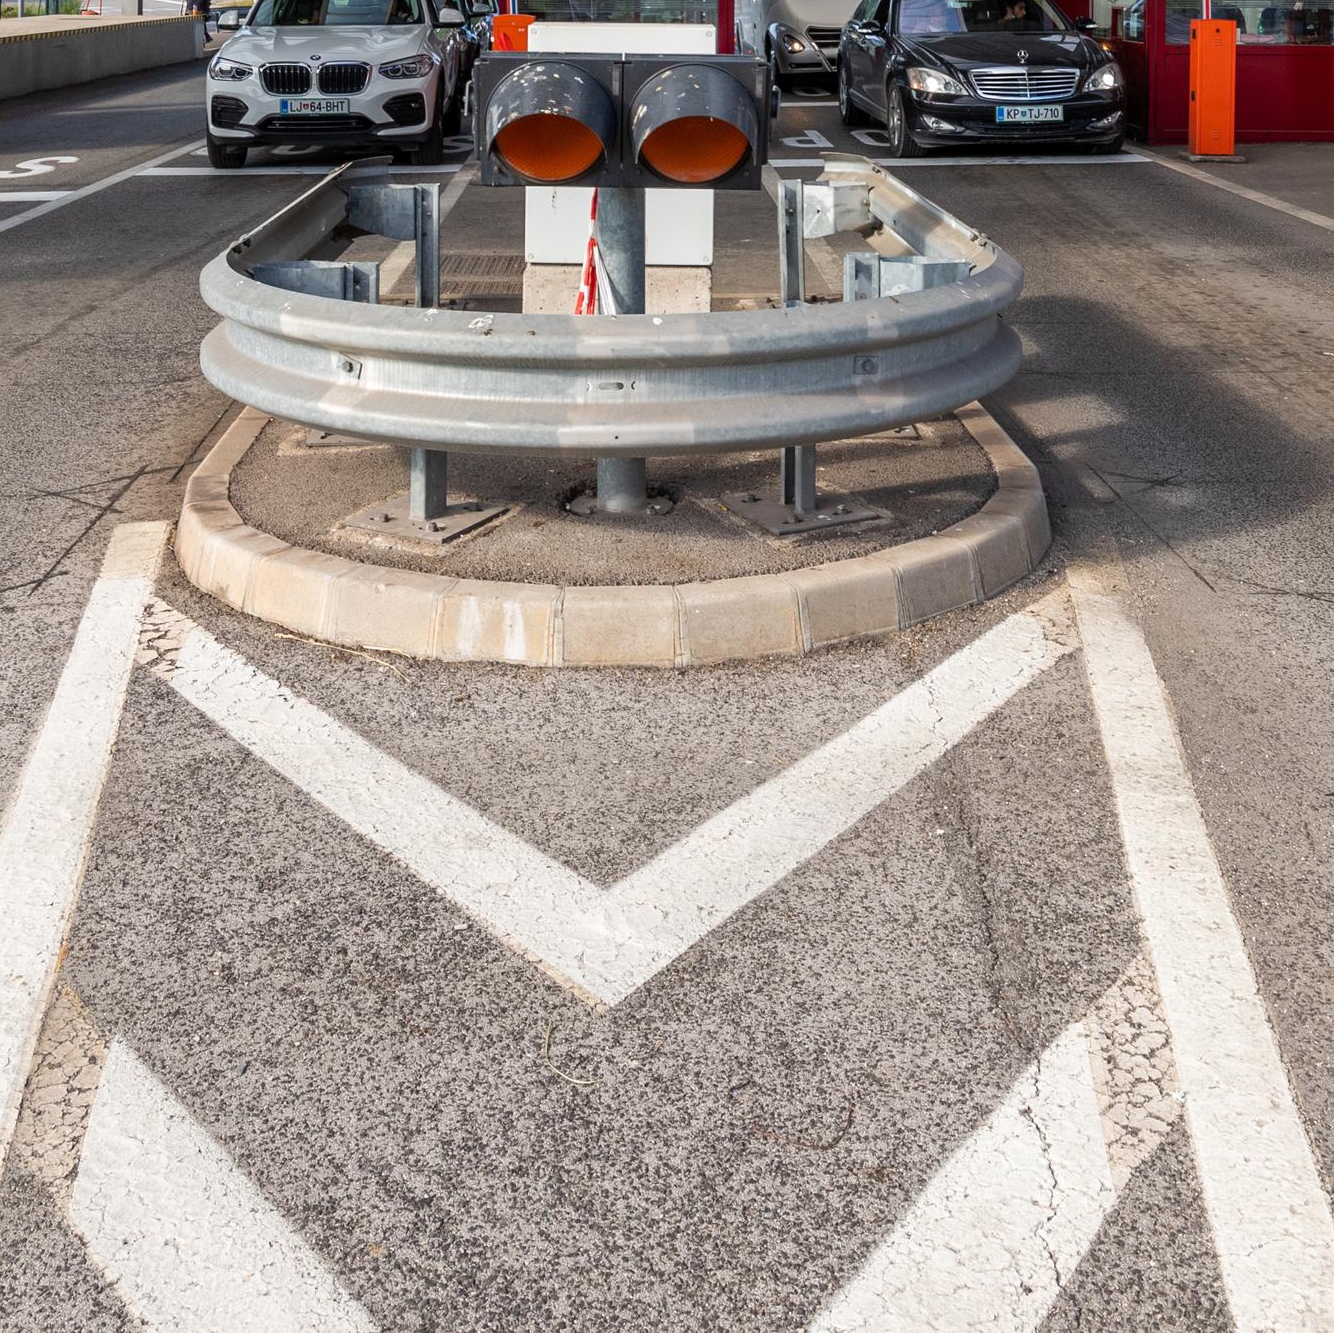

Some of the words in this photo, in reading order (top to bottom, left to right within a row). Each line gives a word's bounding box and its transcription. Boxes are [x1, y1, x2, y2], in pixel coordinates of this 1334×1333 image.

[290, 102, 302, 112] LJ
[310, 101, 345, 112] 64-BHT
[1007, 109, 1019, 119] KP
[1028, 108, 1059, 119] TJ-710
